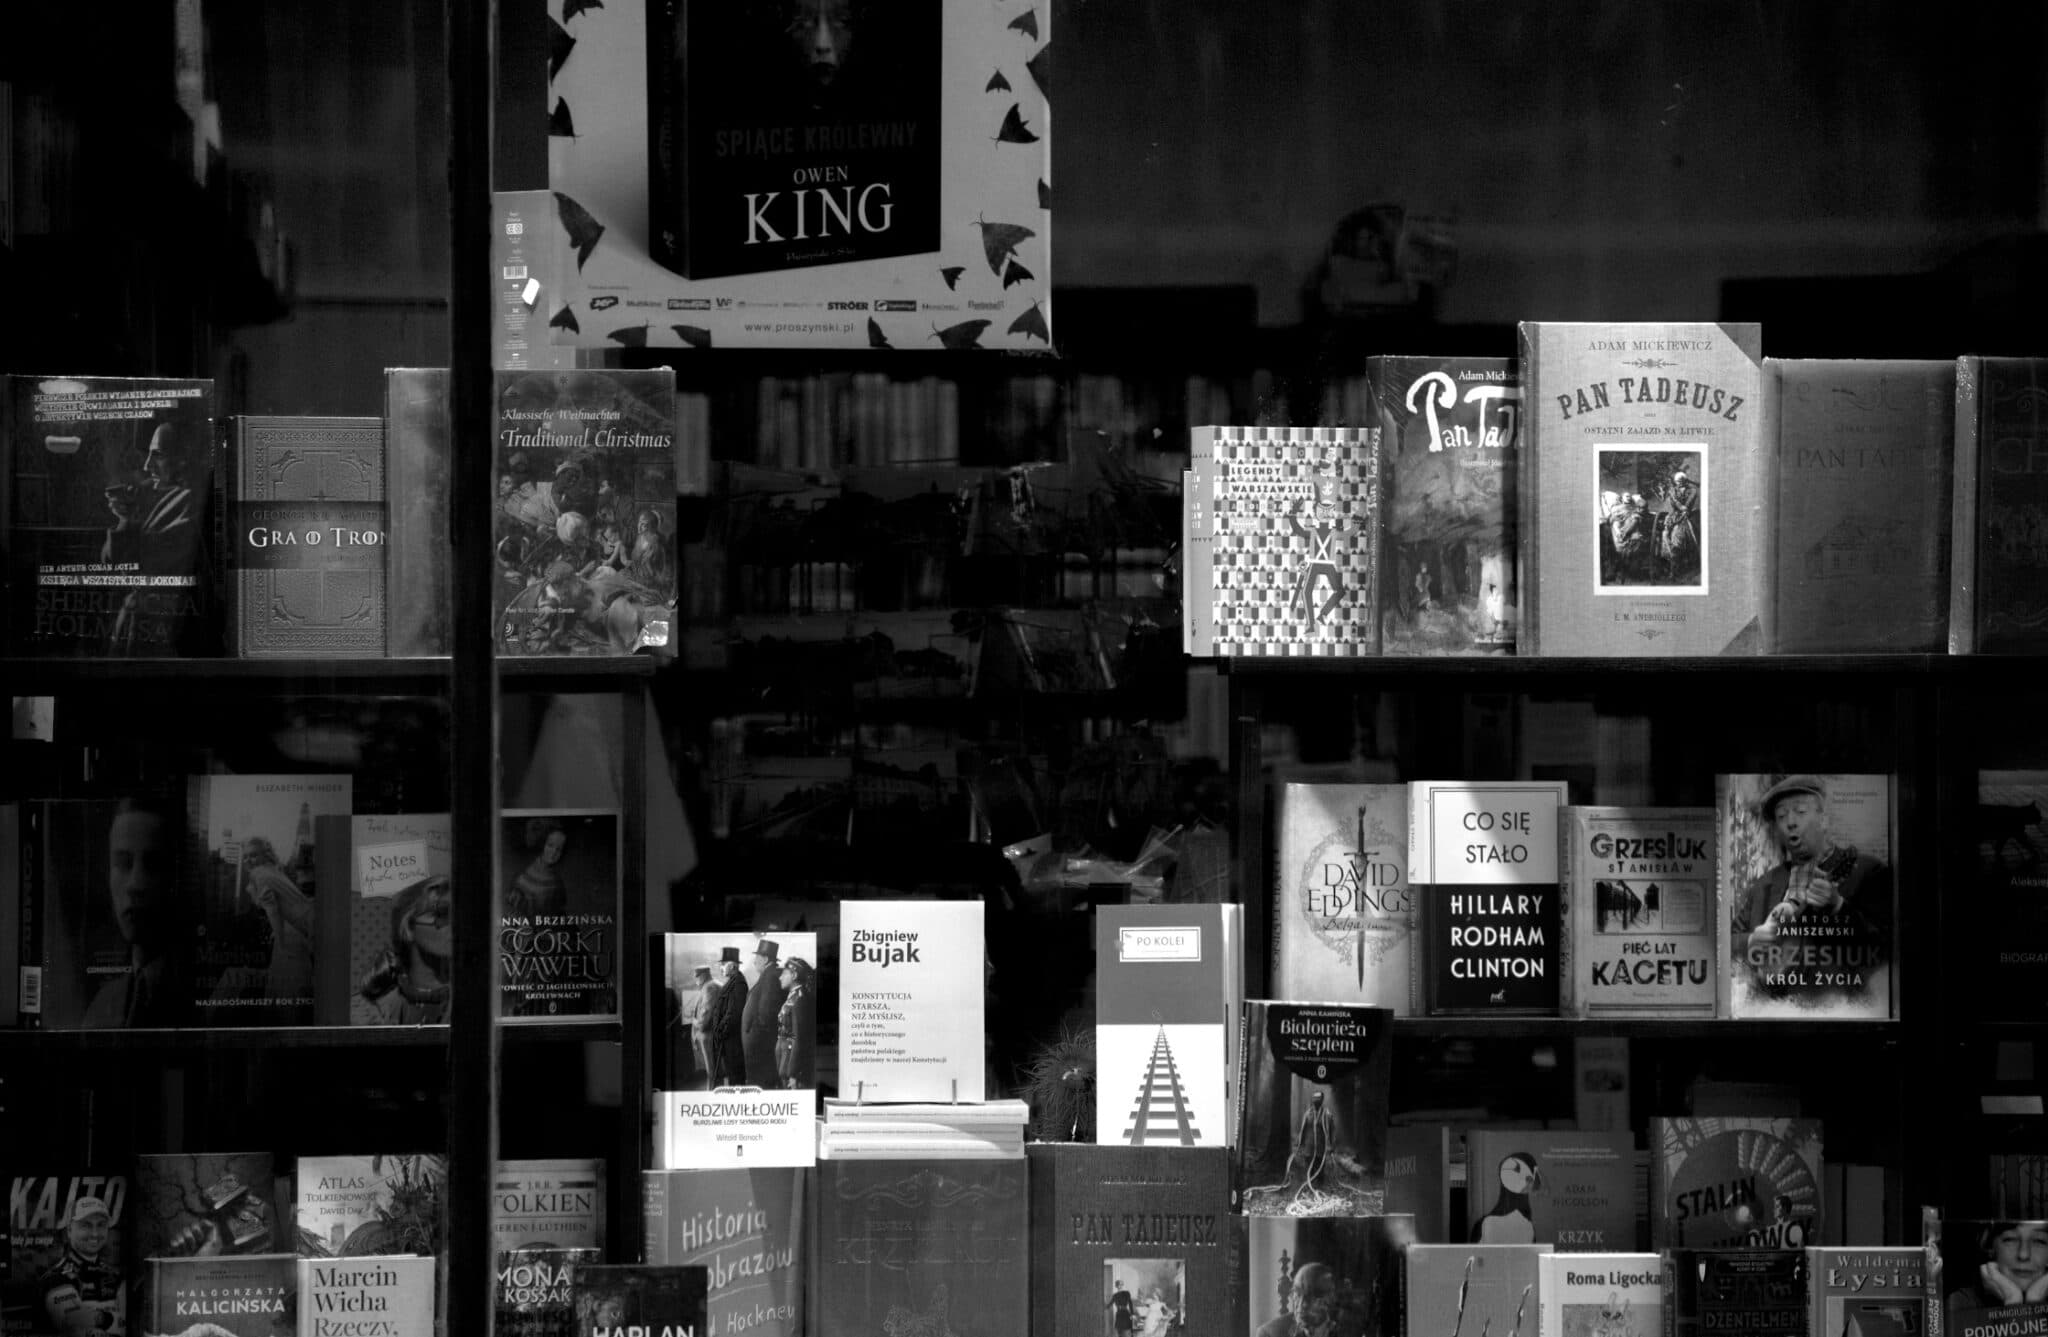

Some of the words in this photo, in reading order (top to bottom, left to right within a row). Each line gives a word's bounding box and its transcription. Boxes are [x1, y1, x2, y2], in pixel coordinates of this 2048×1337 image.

[792, 166, 849, 185] OWEN
[743, 182, 895, 245] KING
[828, 300, 869, 311] STRÖER
[744, 320, 855, 335] www.proszynski.pl
[1588, 341, 1626, 351] ADAM
[1632, 341, 1713, 351] MICKIEWICZ
[1458, 370, 1484, 381] Adam
[1556, 382, 1611, 420] PAN
[1618, 376, 1745, 422] TADEUSZ
[501, 408, 554, 421] Klassische
[1405, 371, 1473, 453] Pan
[500, 427, 590, 448] Traditional
[594, 427, 672, 449] Christmas
[1583, 427, 1624, 435] OSTATNI
[1626, 427, 1662, 435] ZAJAZD
[1664, 427, 1677, 435] NA
[1231, 467, 1281, 475] LEGENDY
[1231, 485, 1312, 493] WARSZAWSKIE
[39, 575, 81, 586] KSIĘGA
[82, 575, 147, 586] WSZYSTKICH
[1463, 811, 1495, 831] CO
[1501, 811, 1531, 835] SIĘ
[1465, 844, 1529, 864] STAŁO
[1589, 831, 1707, 860] GRZESIUK
[369, 854, 417, 870] Notes
[1324, 860, 1399, 891] DAVID
[1308, 885, 1409, 918] EDDINGS
[1450, 893, 1544, 916] HILLARY
[501, 917, 530, 927] NNA
[535, 913, 613, 927] BRZEZIŃSKA
[1779, 914, 1851, 924] BARTOSZ
[853, 930, 919, 945] Zbigniew
[1135, 935, 1151, 946] PO
[1153, 935, 1185, 946] KOLEI
[1450, 926, 1545, 947] RODHAM
[1776, 927, 1855, 937] JANISZEWSKI
[852, 942, 921, 968] Bujak
[1622, 941, 1652, 956] PIĘĆ
[1655, 942, 1677, 954] LAT
[1747, 944, 1882, 967] GRZESIUK
[499, 952, 614, 983] WAWELU
[1450, 957, 1545, 979] CLINTON
[1591, 958, 1708, 986] KACETU
[501, 983, 535, 991] OWIEŚĆ
[1766, 970, 1808, 986] KRÓL
[1814, 970, 1864, 986] ŻYCIA
[852, 992, 913, 1000] KONSTYTUCJA
[851, 1003, 891, 1011] STARSZA,
[851, 1012, 867, 1020] NIŻ
[1290, 1037, 1355, 1057] szeptem
[680, 1102, 800, 1118] RADZIWIŁŁOWIE
[318, 1176, 366, 1190] ATLAS
[1565, 1184, 1597, 1193] ADAM
[304, 1192, 376, 1203] TOLKIENOWSKI
[1675, 1175, 1756, 1222] STALIN
[682, 1200, 768, 1252] Historia
[1071, 1214, 1113, 1243] PAN
[1121, 1214, 1217, 1243] TADEUSZ
[1558, 1230, 1604, 1244] KRZYK
[1837, 1255, 1921, 1268] Waldema
[314, 1264, 400, 1288] Marcin
[497, 1265, 573, 1288] MONA
[1566, 1271, 1605, 1286] Roma
[1609, 1270, 1661, 1288] Ligocka
[1827, 1268, 1922, 1293] Łysia
[314, 1290, 389, 1313] Wicha
[505, 1287, 572, 1303] KOSSAK
[175, 1297, 286, 1316] KALICIŃSKA
[314, 1317, 400, 1337] Rzeczy.
[727, 1303, 796, 1335] Hockney
[1964, 1318, 2048, 1337] PODWÓJNE
